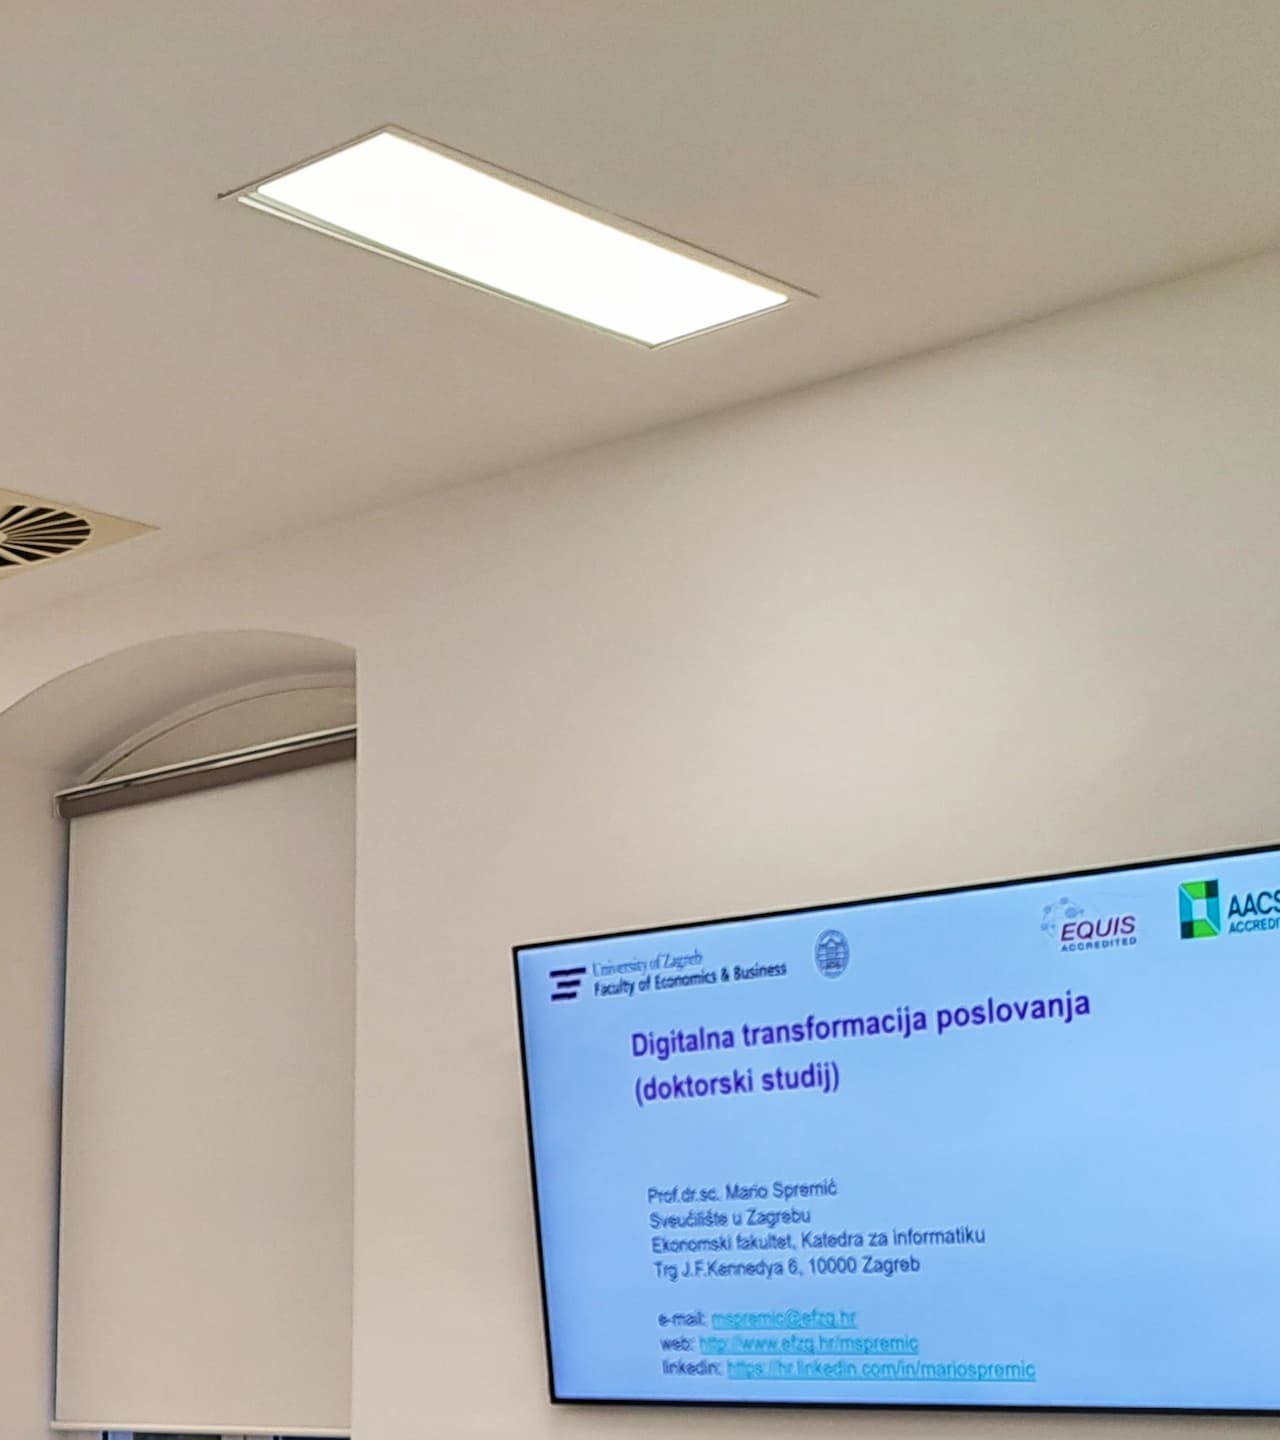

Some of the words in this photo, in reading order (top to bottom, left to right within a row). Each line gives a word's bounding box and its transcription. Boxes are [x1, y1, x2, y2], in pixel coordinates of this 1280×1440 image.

[1060, 915, 1136, 942] EQUIS
[1228, 917, 1280, 933] ACCREDI
[1060, 936, 1137, 952] ACCREDITED
[592, 955, 648, 977] University
[649, 952, 663, 969] of
[662, 948, 703, 970] Zagreb
[594, 975, 634, 997] Faculty
[638, 974, 651, 992] of
[655, 969, 716, 991] Economics
[721, 967, 730, 982] &
[734, 962, 787, 981] Business
[632, 1026, 734, 1061] Digitalna
[742, 1006, 927, 1047] transformacija
[937, 989, 1090, 1035] poslovanja
[634, 1068, 753, 1107] (doktorski
[761, 1061, 840, 1093] studij)
[726, 1183, 769, 1201] Mario
[773, 1178, 837, 1202] Spremić
[733, 1213, 742, 1226] u
[746, 1208, 811, 1230] Zagrebu
[652, 1235, 731, 1254] Ekonomski
[802, 1231, 863, 1249] Katedra
[868, 1232, 888, 1246] za
[893, 1225, 986, 1245] informatiku
[654, 1262, 679, 1282] Trg
[681, 1260, 784, 1280] J.F.Kennedya
[809, 1256, 858, 1274] 10000
[862, 1255, 920, 1277] Zagreb
[660, 1337, 695, 1352] web:
